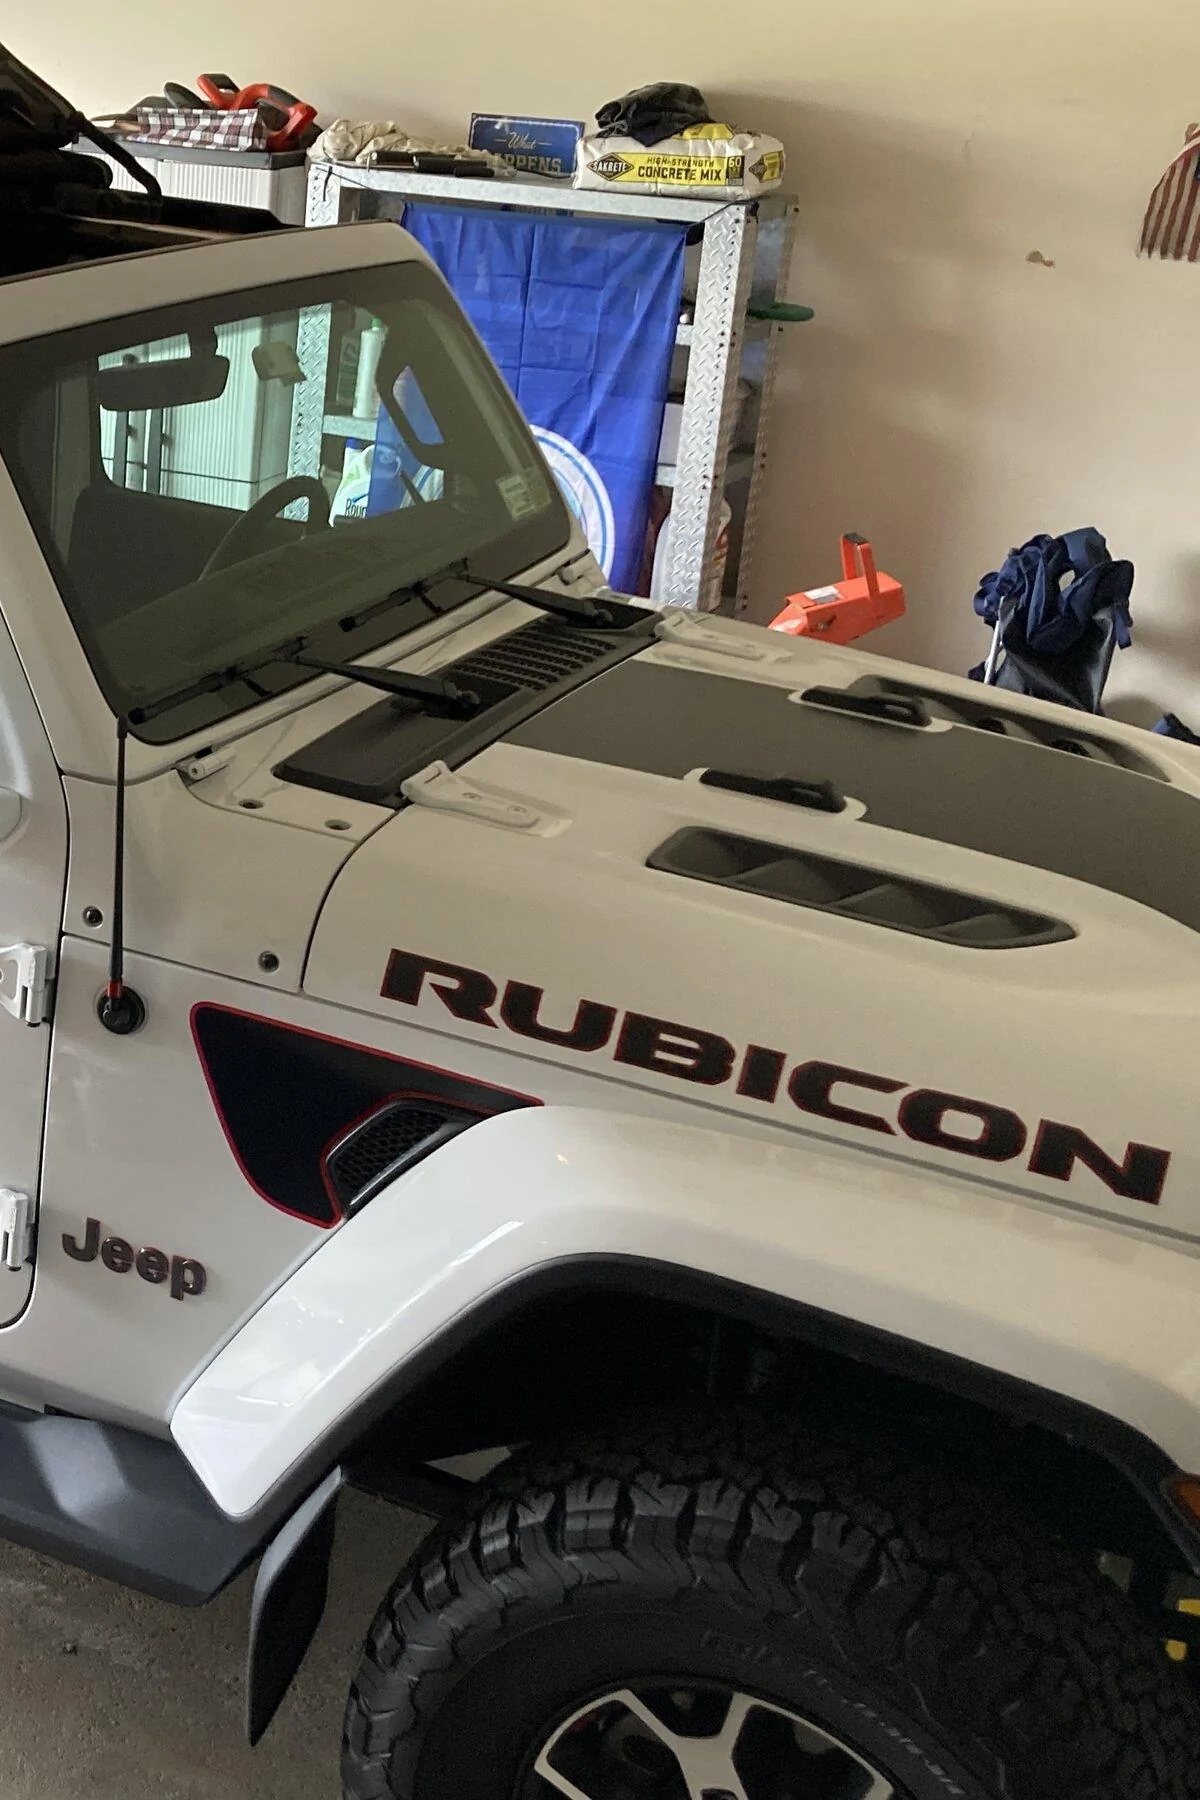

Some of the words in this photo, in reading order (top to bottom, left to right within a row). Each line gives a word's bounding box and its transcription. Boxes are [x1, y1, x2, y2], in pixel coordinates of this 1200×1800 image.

[507, 131, 537, 150] What
[593, 160, 628, 173] SAKRETE
[647, 156, 715, 168] HIGH-STRENGTH
[728, 156, 742, 168] 60
[638, 166, 697, 180] CONCRETE
[700, 168, 722, 181] MIX
[380, 947, 1173, 1206] RUBICON
[61, 1216, 208, 1301] Jeep
